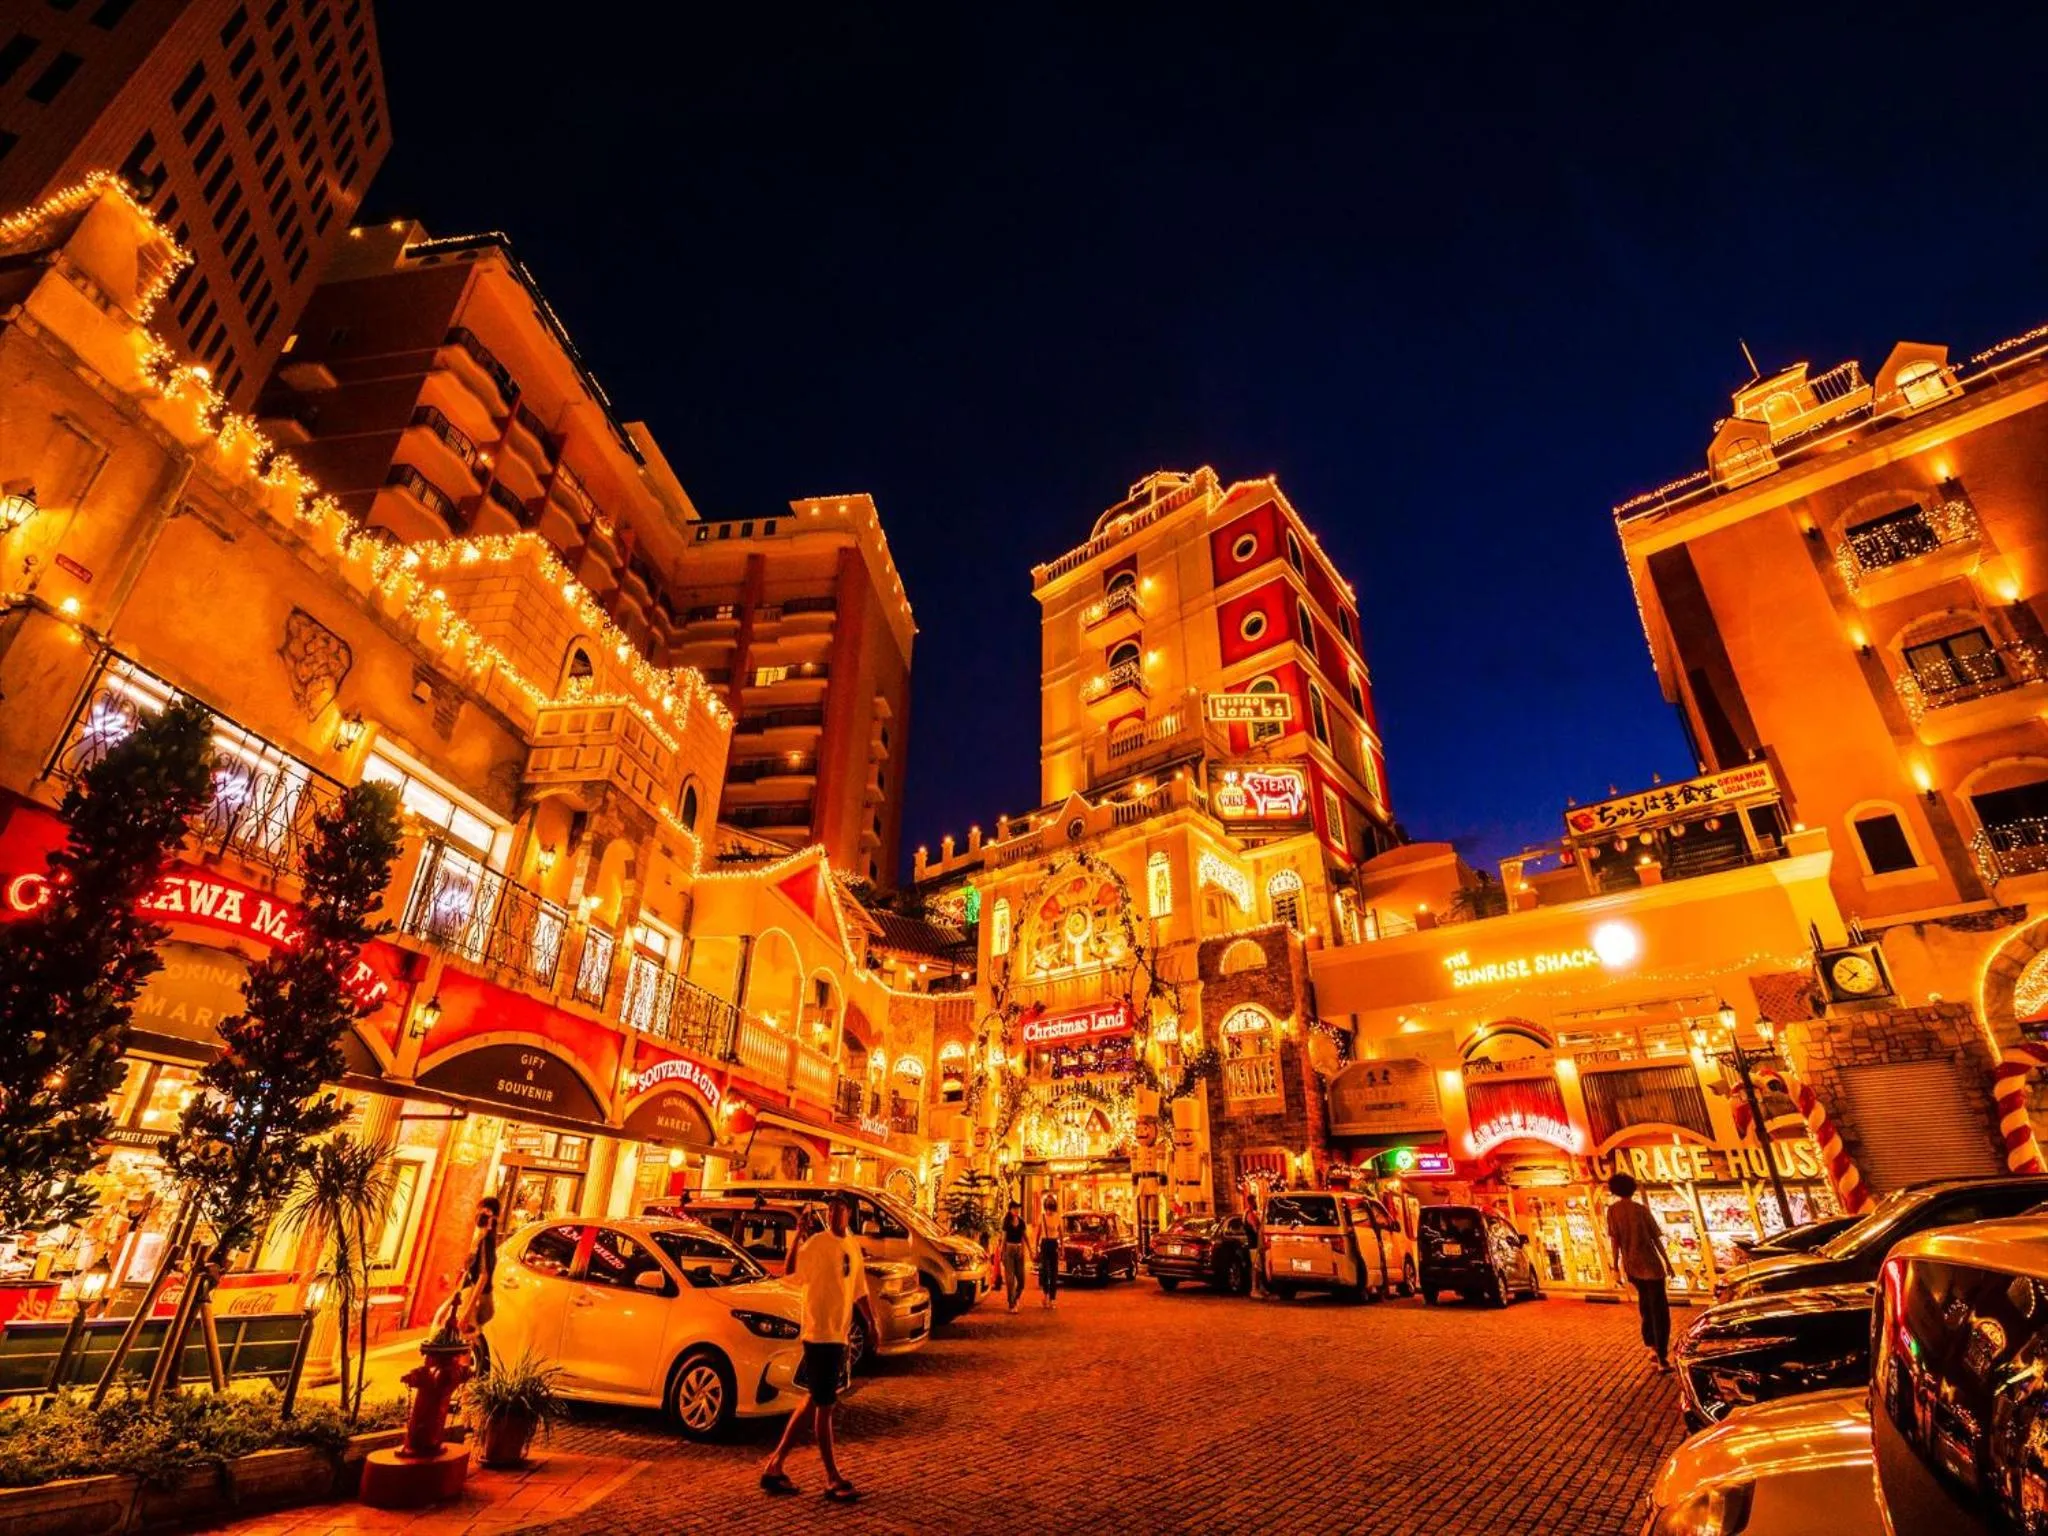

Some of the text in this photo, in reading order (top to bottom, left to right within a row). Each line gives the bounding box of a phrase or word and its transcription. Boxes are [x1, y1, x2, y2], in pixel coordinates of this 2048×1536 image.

[1253, 778, 1295, 793] STEAK
[1597, 784, 1719, 827] ちゅらはま食堂
[1454, 949, 1600, 988] SUNRISE SHACK
[1023, 1007, 1126, 1042] Christmas Land
[521, 1053, 546, 1069] GIFT
[497, 1079, 553, 1102] SOUVENIR
[639, 1060, 720, 1108] SOUVENIR & GIFT
[656, 1116, 692, 1132] MARKET
[1595, 1139, 1819, 1182] GARAGE HOUS
